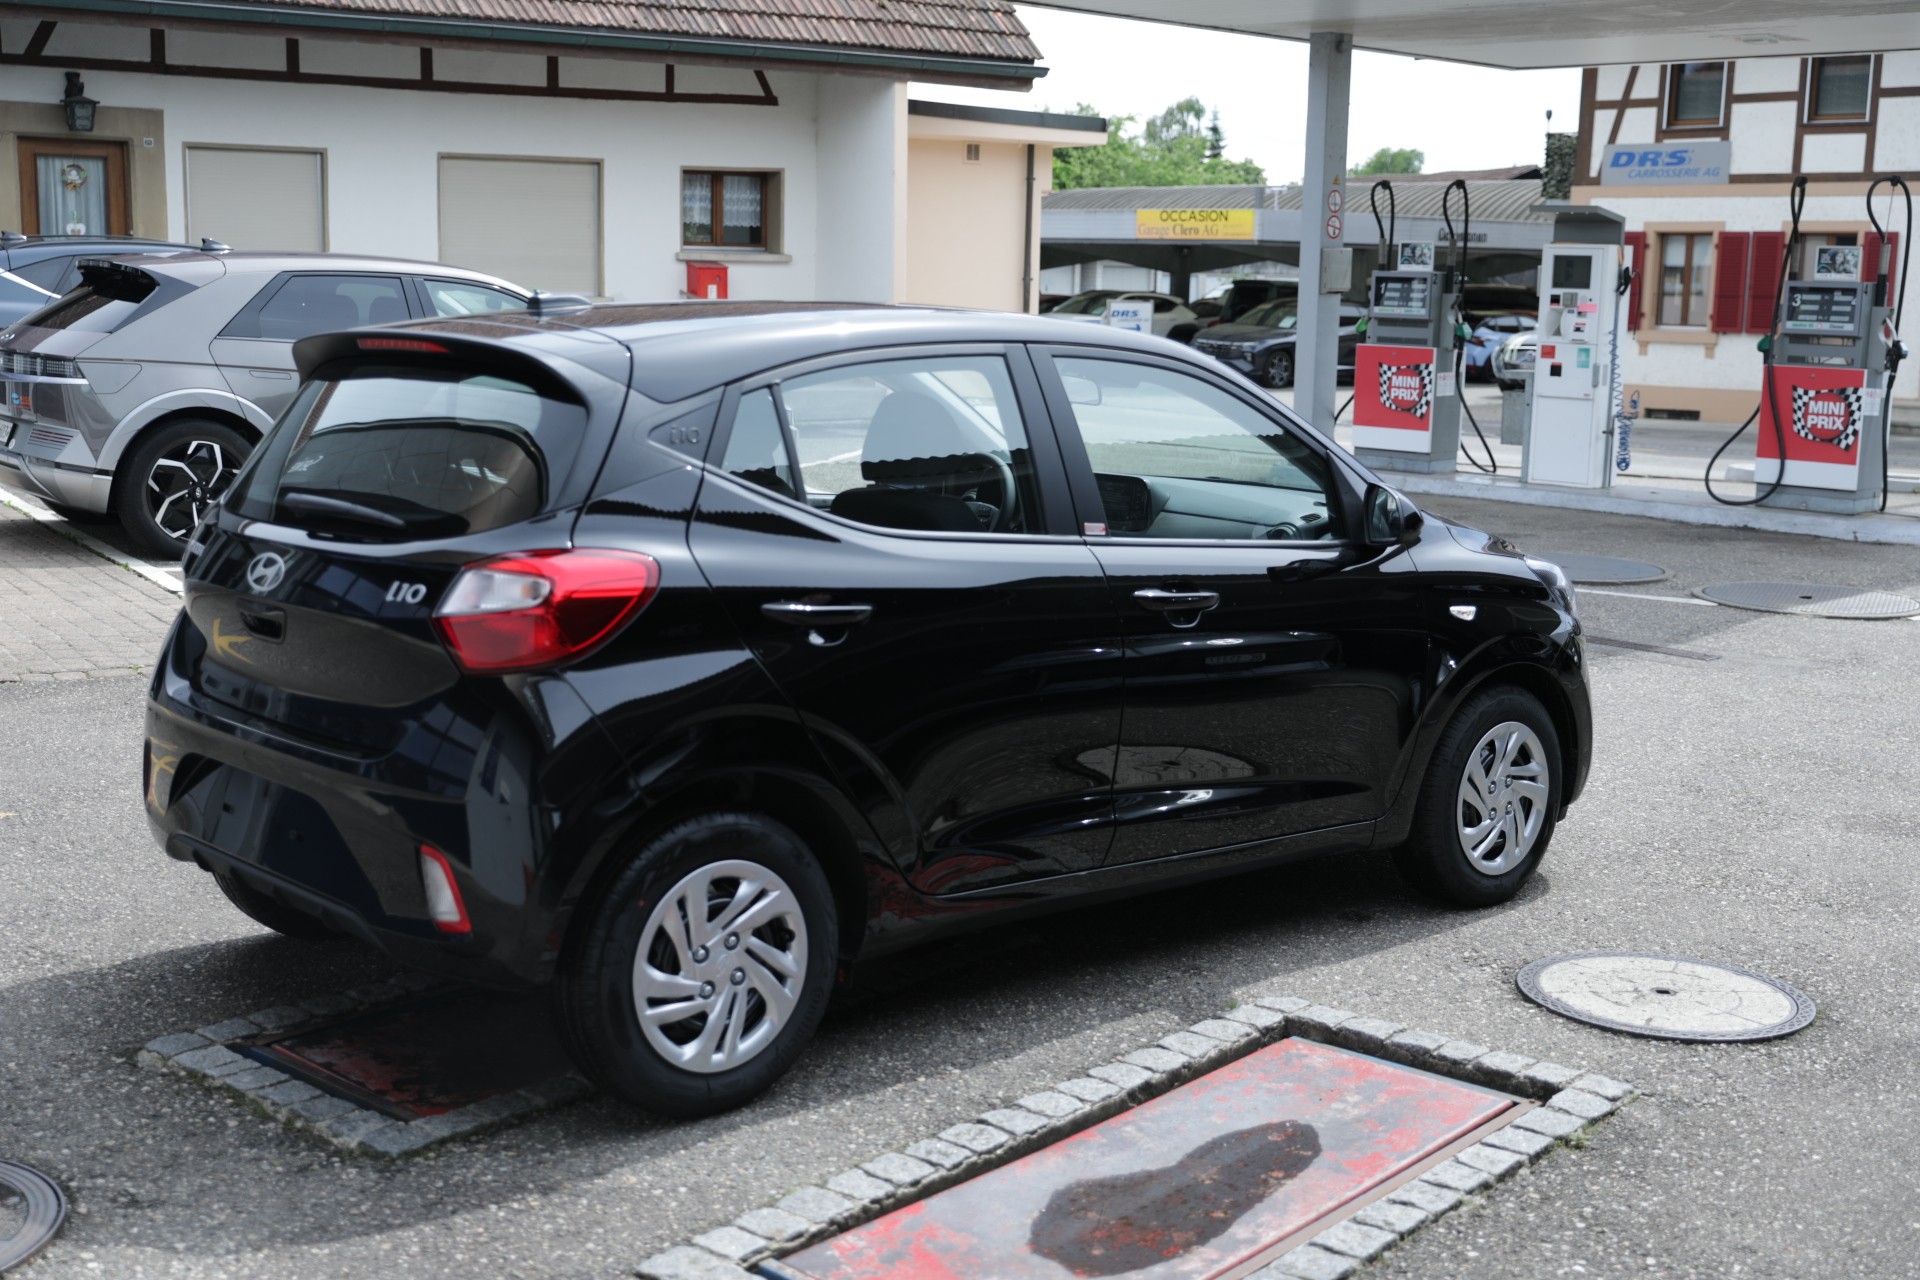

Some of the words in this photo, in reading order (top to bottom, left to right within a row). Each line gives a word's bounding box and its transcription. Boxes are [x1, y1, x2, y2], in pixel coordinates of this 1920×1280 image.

[1610, 149, 1690, 168] DRS
[1628, 167, 1699, 179] CARROSSERIE
[1703, 167, 1721, 177] AG
[1160, 210, 1229, 222] OCCASION
[1138, 223, 1170, 238] Garage
[1172, 223, 1200, 236] Clero
[1202, 225, 1219, 236] AG
[1792, 293, 1802, 307] 3
[1111, 310, 1139, 318] DRS
[1391, 375, 1420, 389] MINI
[1390, 387, 1420, 402] PRIX
[1808, 400, 1846, 416] MINI
[1806, 415, 1845, 431] PRIX
